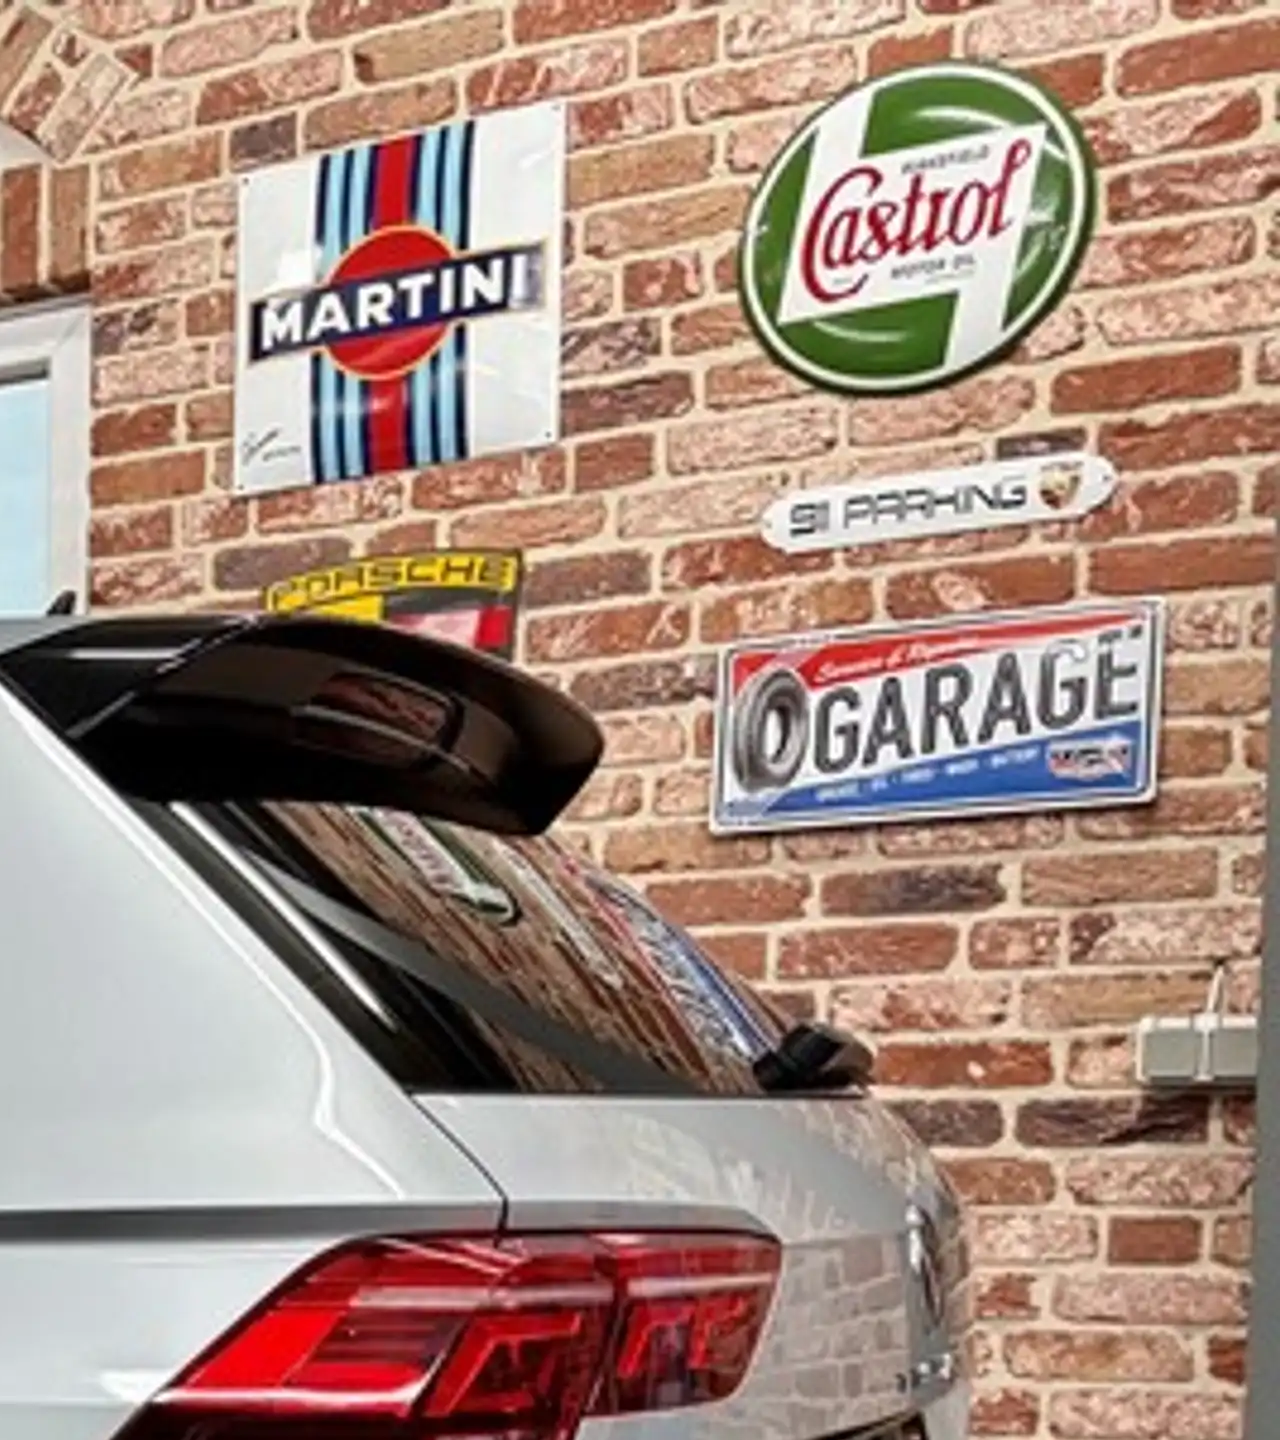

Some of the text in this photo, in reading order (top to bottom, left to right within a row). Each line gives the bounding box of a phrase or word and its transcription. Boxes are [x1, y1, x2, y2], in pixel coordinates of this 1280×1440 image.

[801, 137, 1033, 304] Castrol
[259, 253, 529, 352] MARTINI
[843, 474, 1027, 529] PARKING
[272, 554, 513, 612] PORSCHE
[813, 626, 1144, 775] GARAGE
